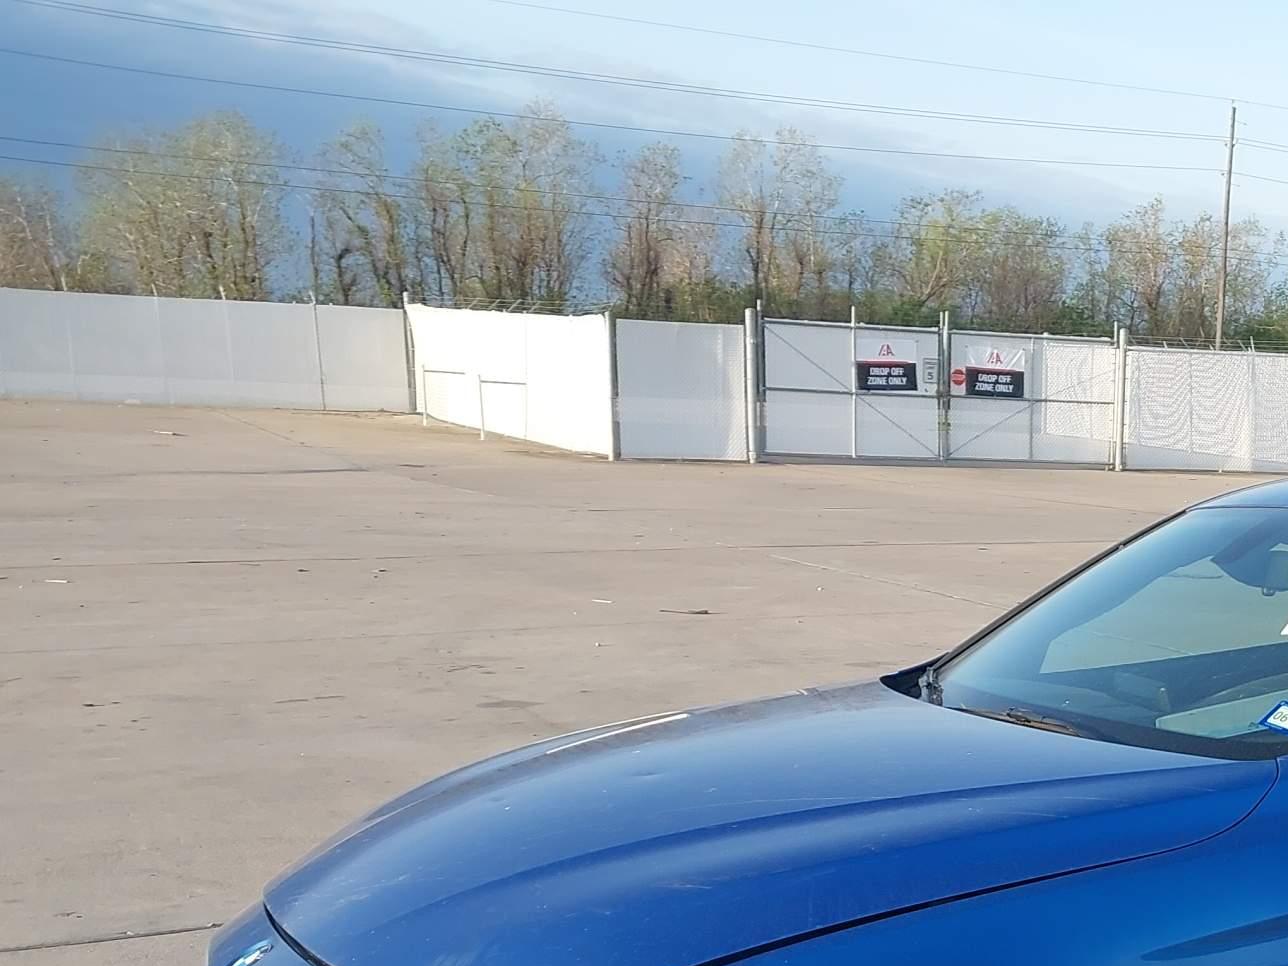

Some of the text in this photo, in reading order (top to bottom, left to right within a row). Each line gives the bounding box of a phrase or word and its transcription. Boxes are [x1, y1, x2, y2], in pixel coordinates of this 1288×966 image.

[869, 367, 904, 376] DROP OFF
[928, 371, 934, 380] 5
[867, 376, 908, 385] ZONE ONLY
[977, 373, 997, 382] DROP
[998, 374, 1013, 384] OFF
[974, 382, 1014, 393] ZONE ONLY
